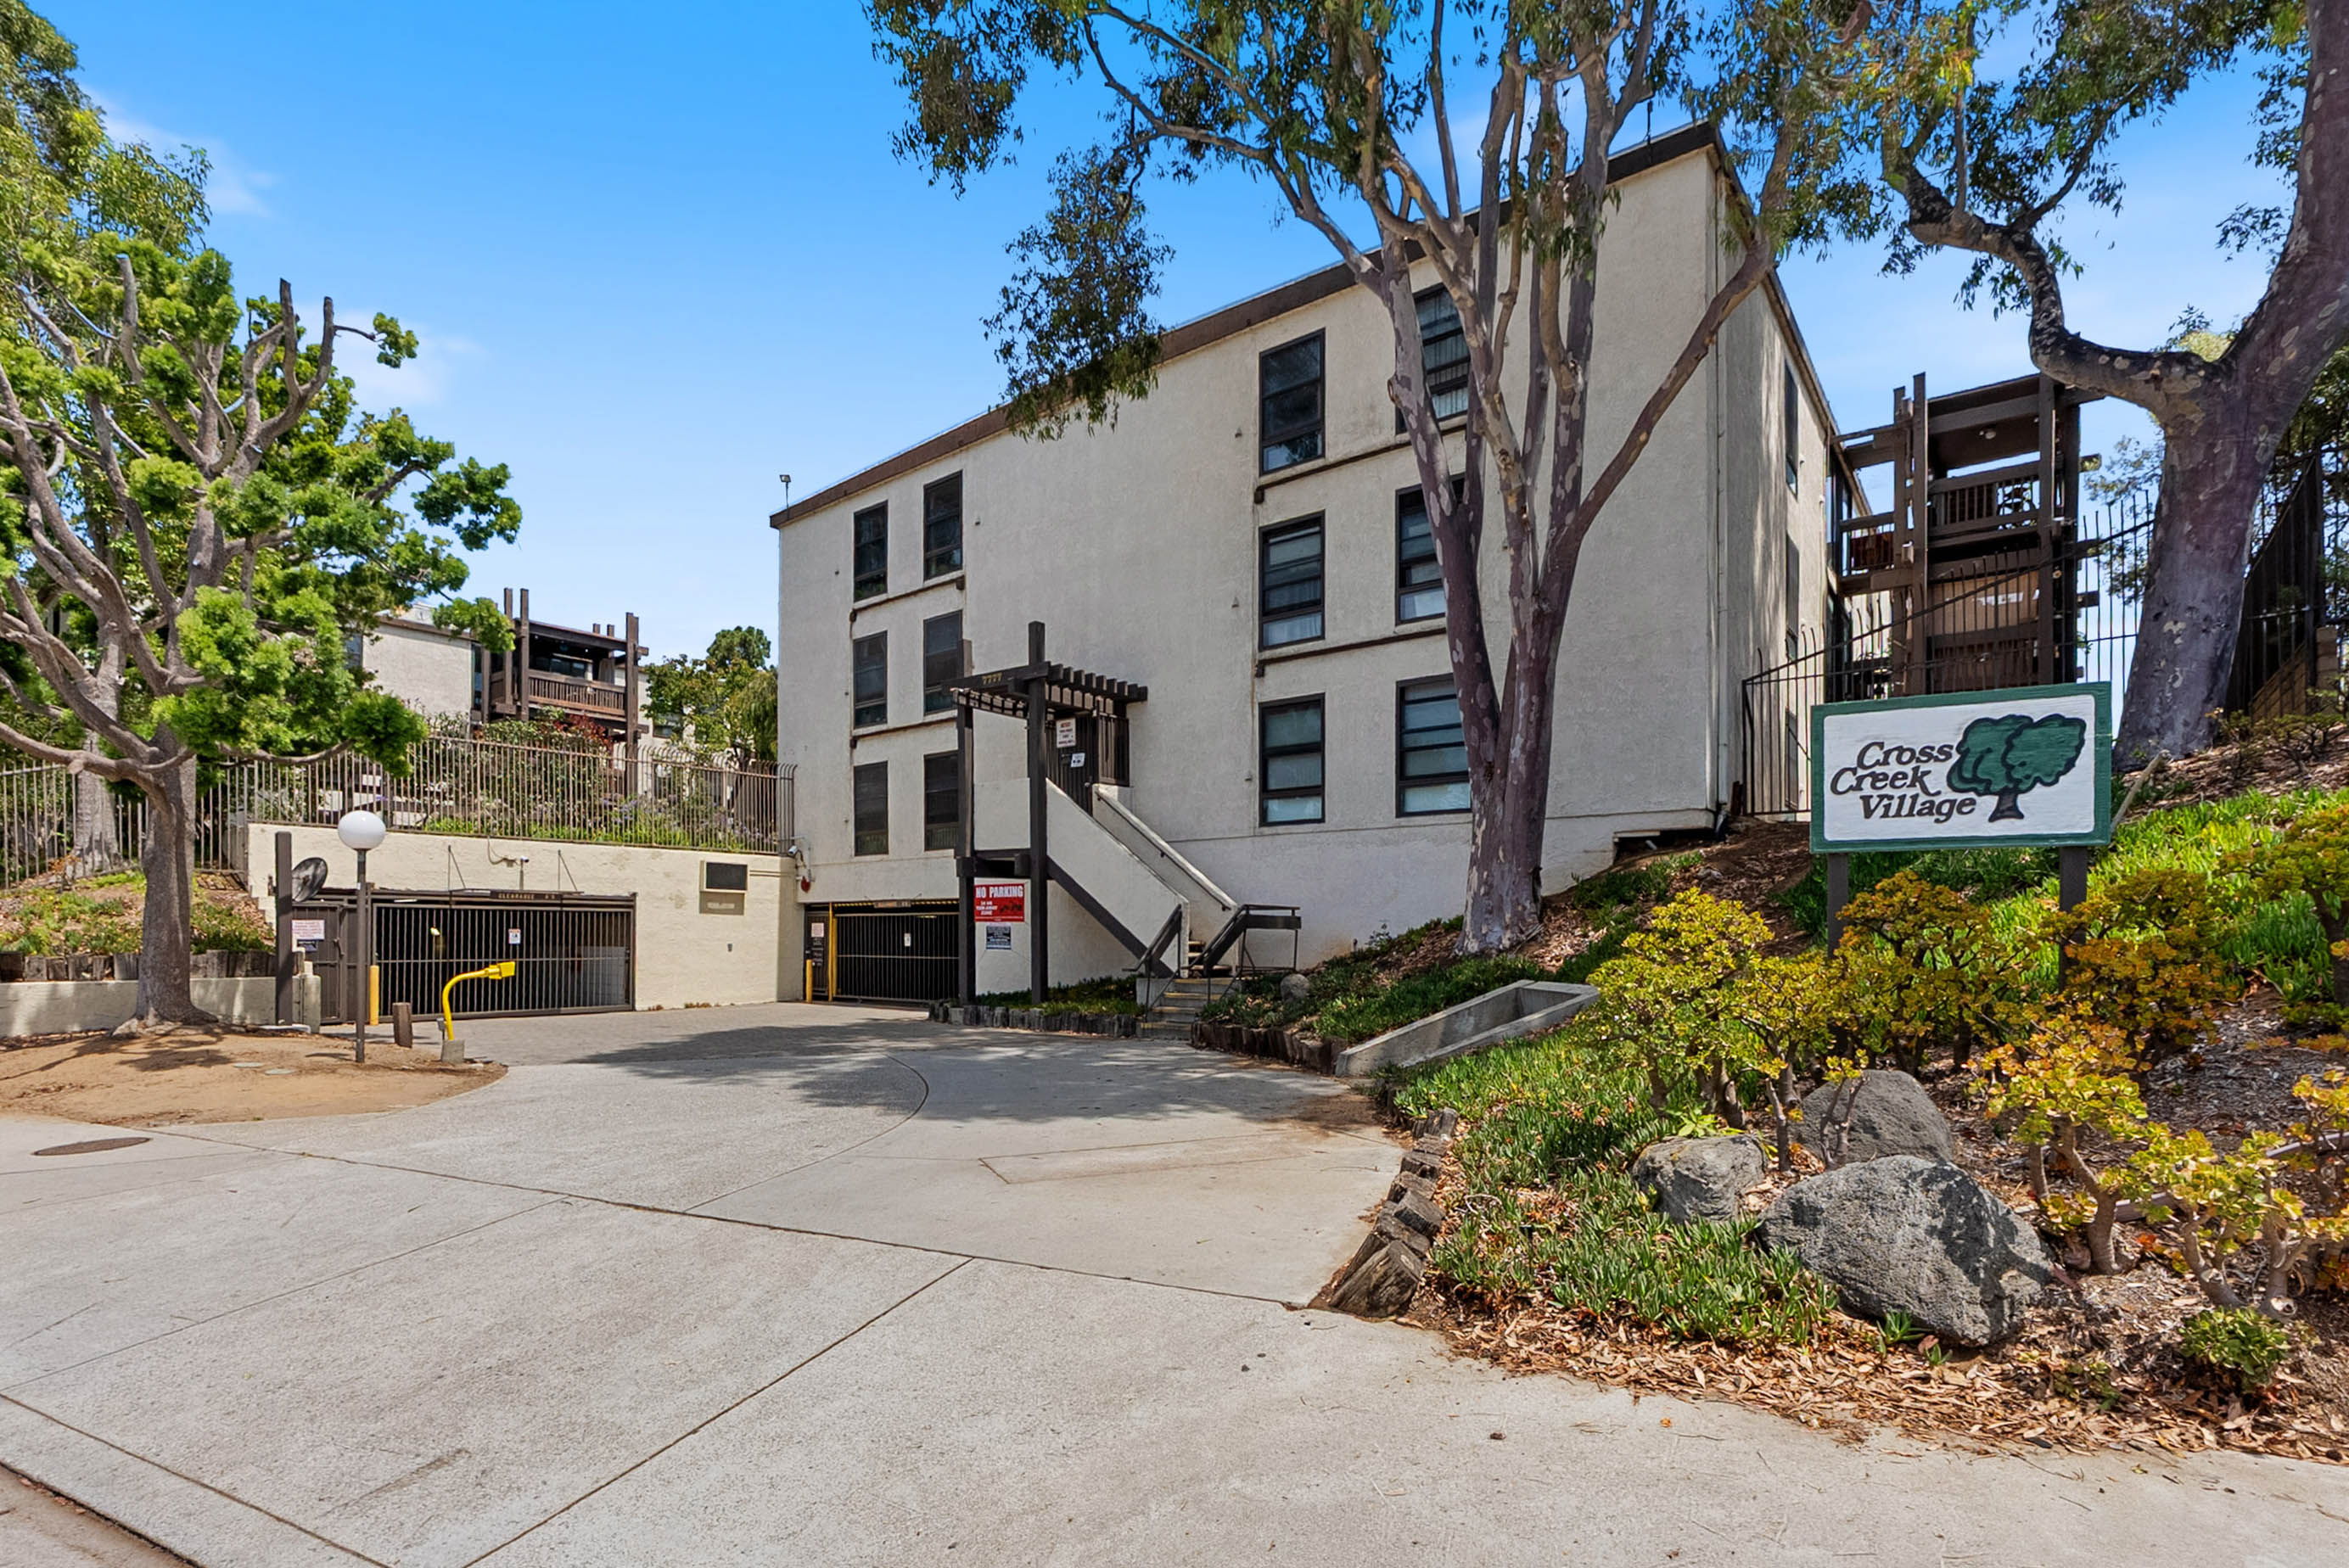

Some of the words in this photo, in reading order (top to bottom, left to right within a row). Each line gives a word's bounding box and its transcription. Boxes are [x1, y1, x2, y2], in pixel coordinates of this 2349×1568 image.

[1856, 741, 1954, 770] Cross
[1830, 765, 1943, 797] Creek
[1859, 794, 1976, 824] Village
[975, 886, 986, 899] NO
[989, 885, 1023, 899] PARKING
